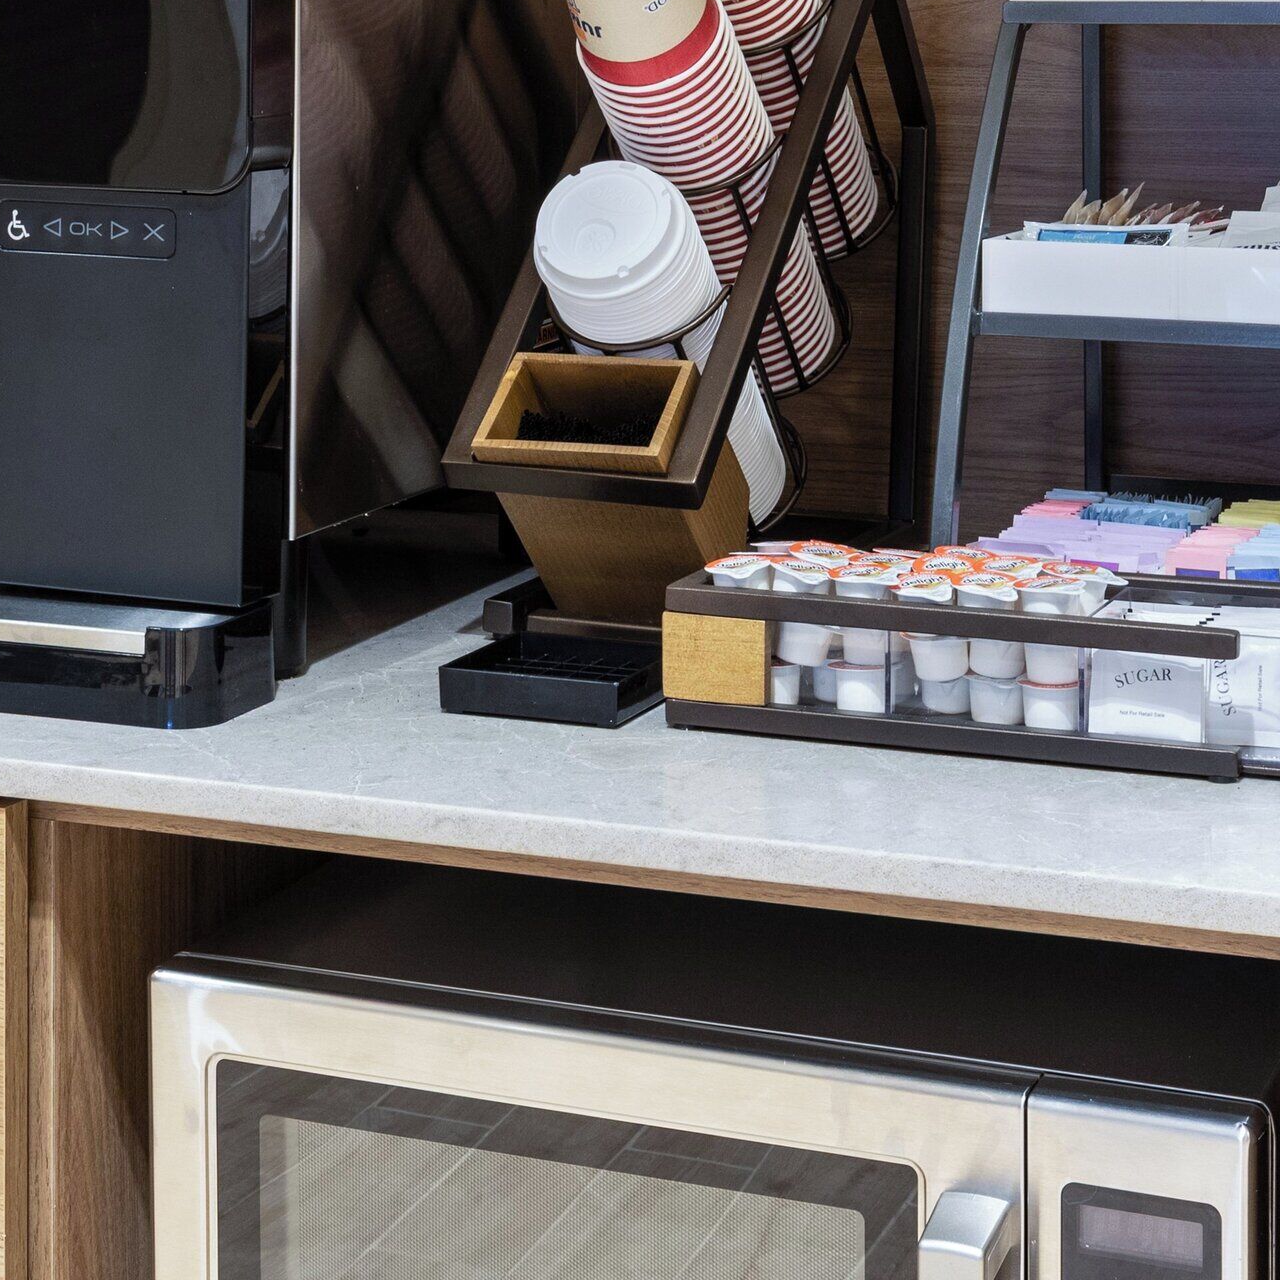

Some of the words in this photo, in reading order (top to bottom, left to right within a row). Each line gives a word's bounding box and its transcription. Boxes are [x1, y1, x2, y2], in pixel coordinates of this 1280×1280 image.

[69, 222, 103, 237] OK
[925, 559, 967, 570] delight
[901, 575, 946, 588] delight
[963, 575, 1005, 585] delight
[1114, 668, 1172, 689] SUGAR
[1214, 659, 1237, 717] SUGAR
